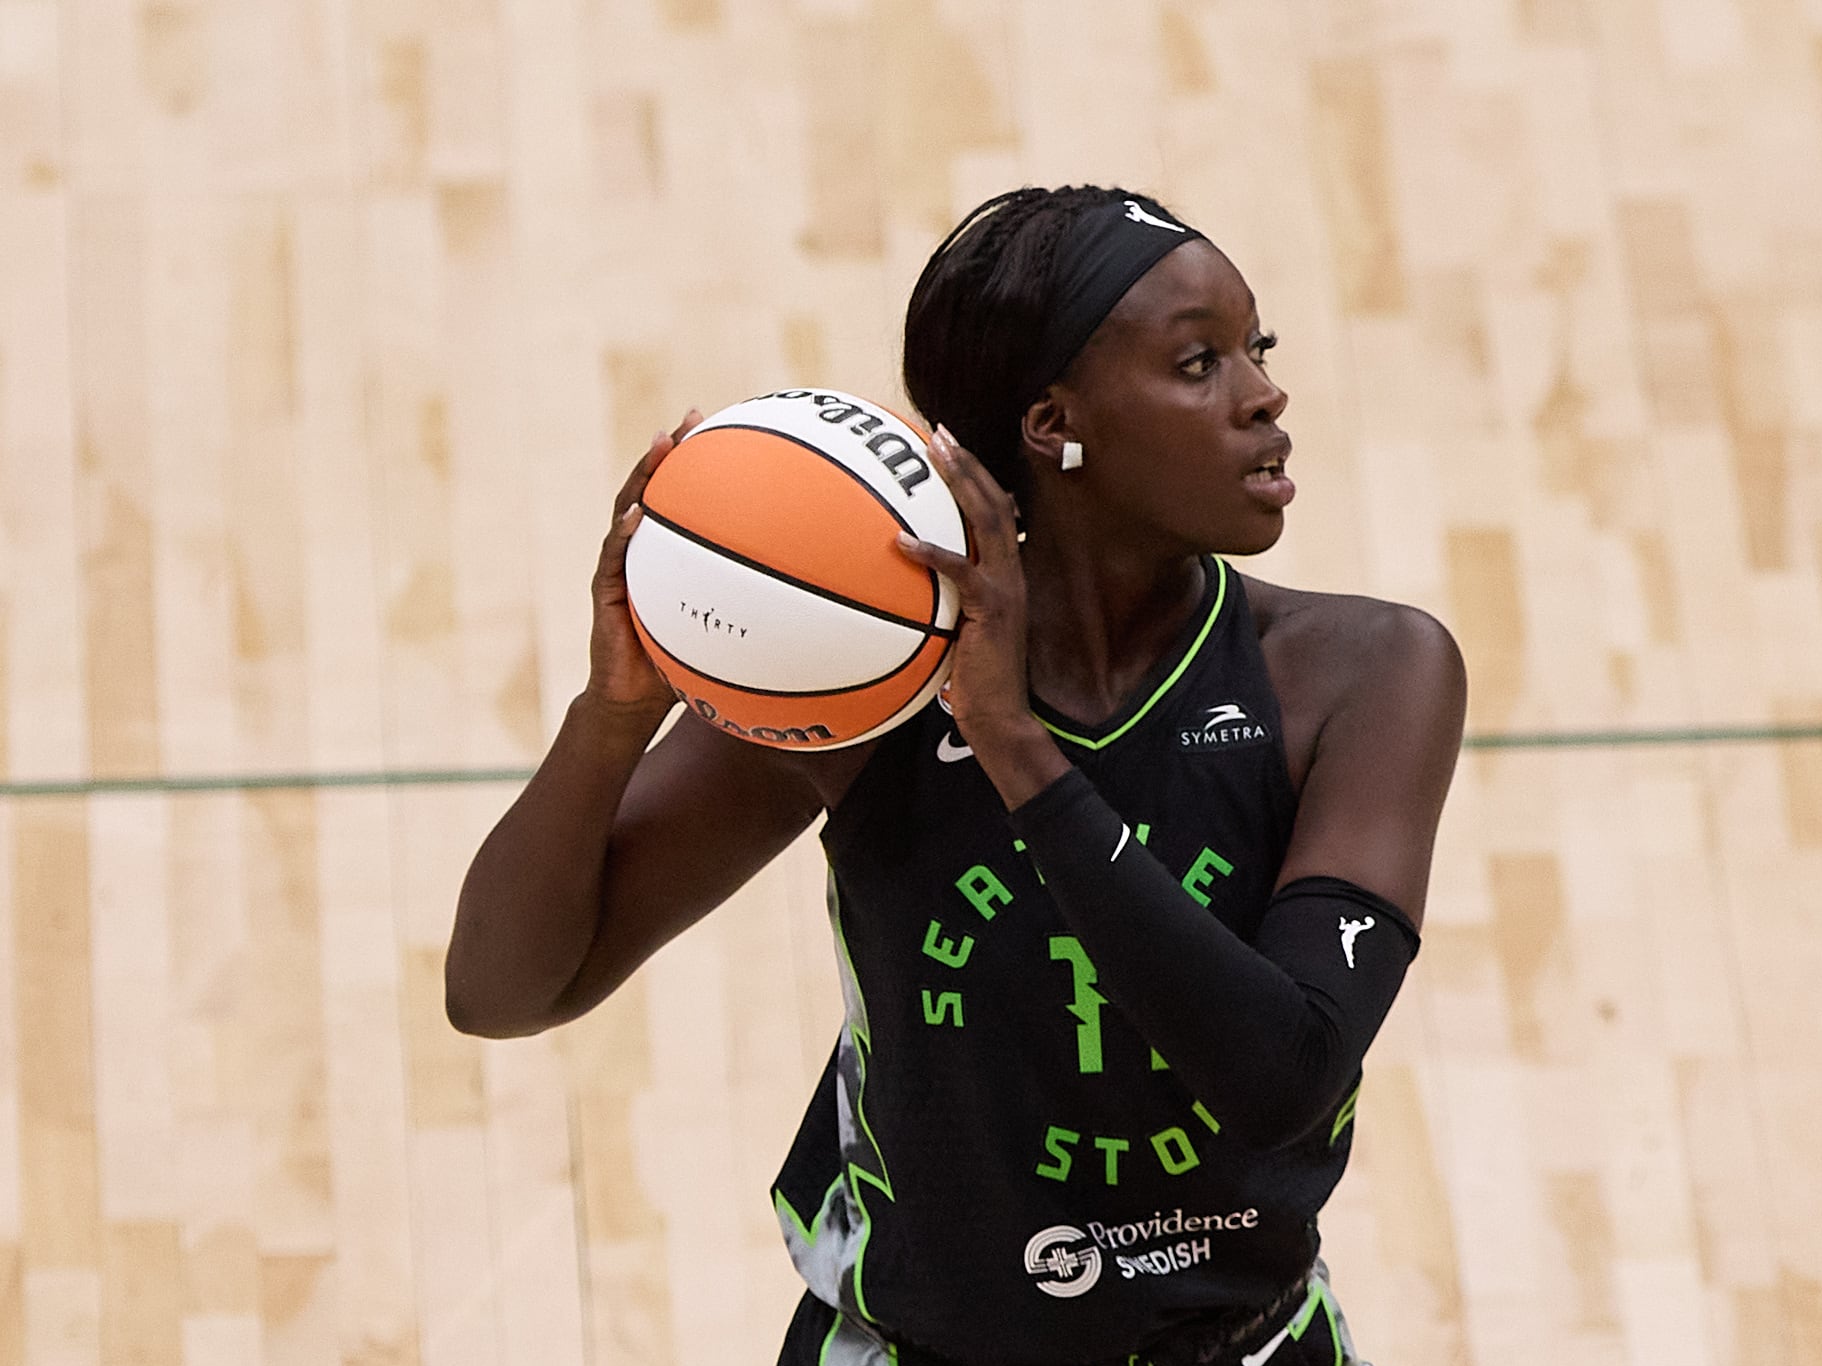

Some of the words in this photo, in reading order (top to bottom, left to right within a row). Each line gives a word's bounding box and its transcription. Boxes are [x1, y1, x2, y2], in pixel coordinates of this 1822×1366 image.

[741, 390, 931, 497] Wilso
[1181, 725, 1265, 746] SYMETRA
[921, 823, 1234, 1028] SEAE
[1035, 1099, 1221, 1186] STO
[1087, 1207, 1259, 1250] Providence
[1116, 1237, 1211, 1279] SWEDISH
